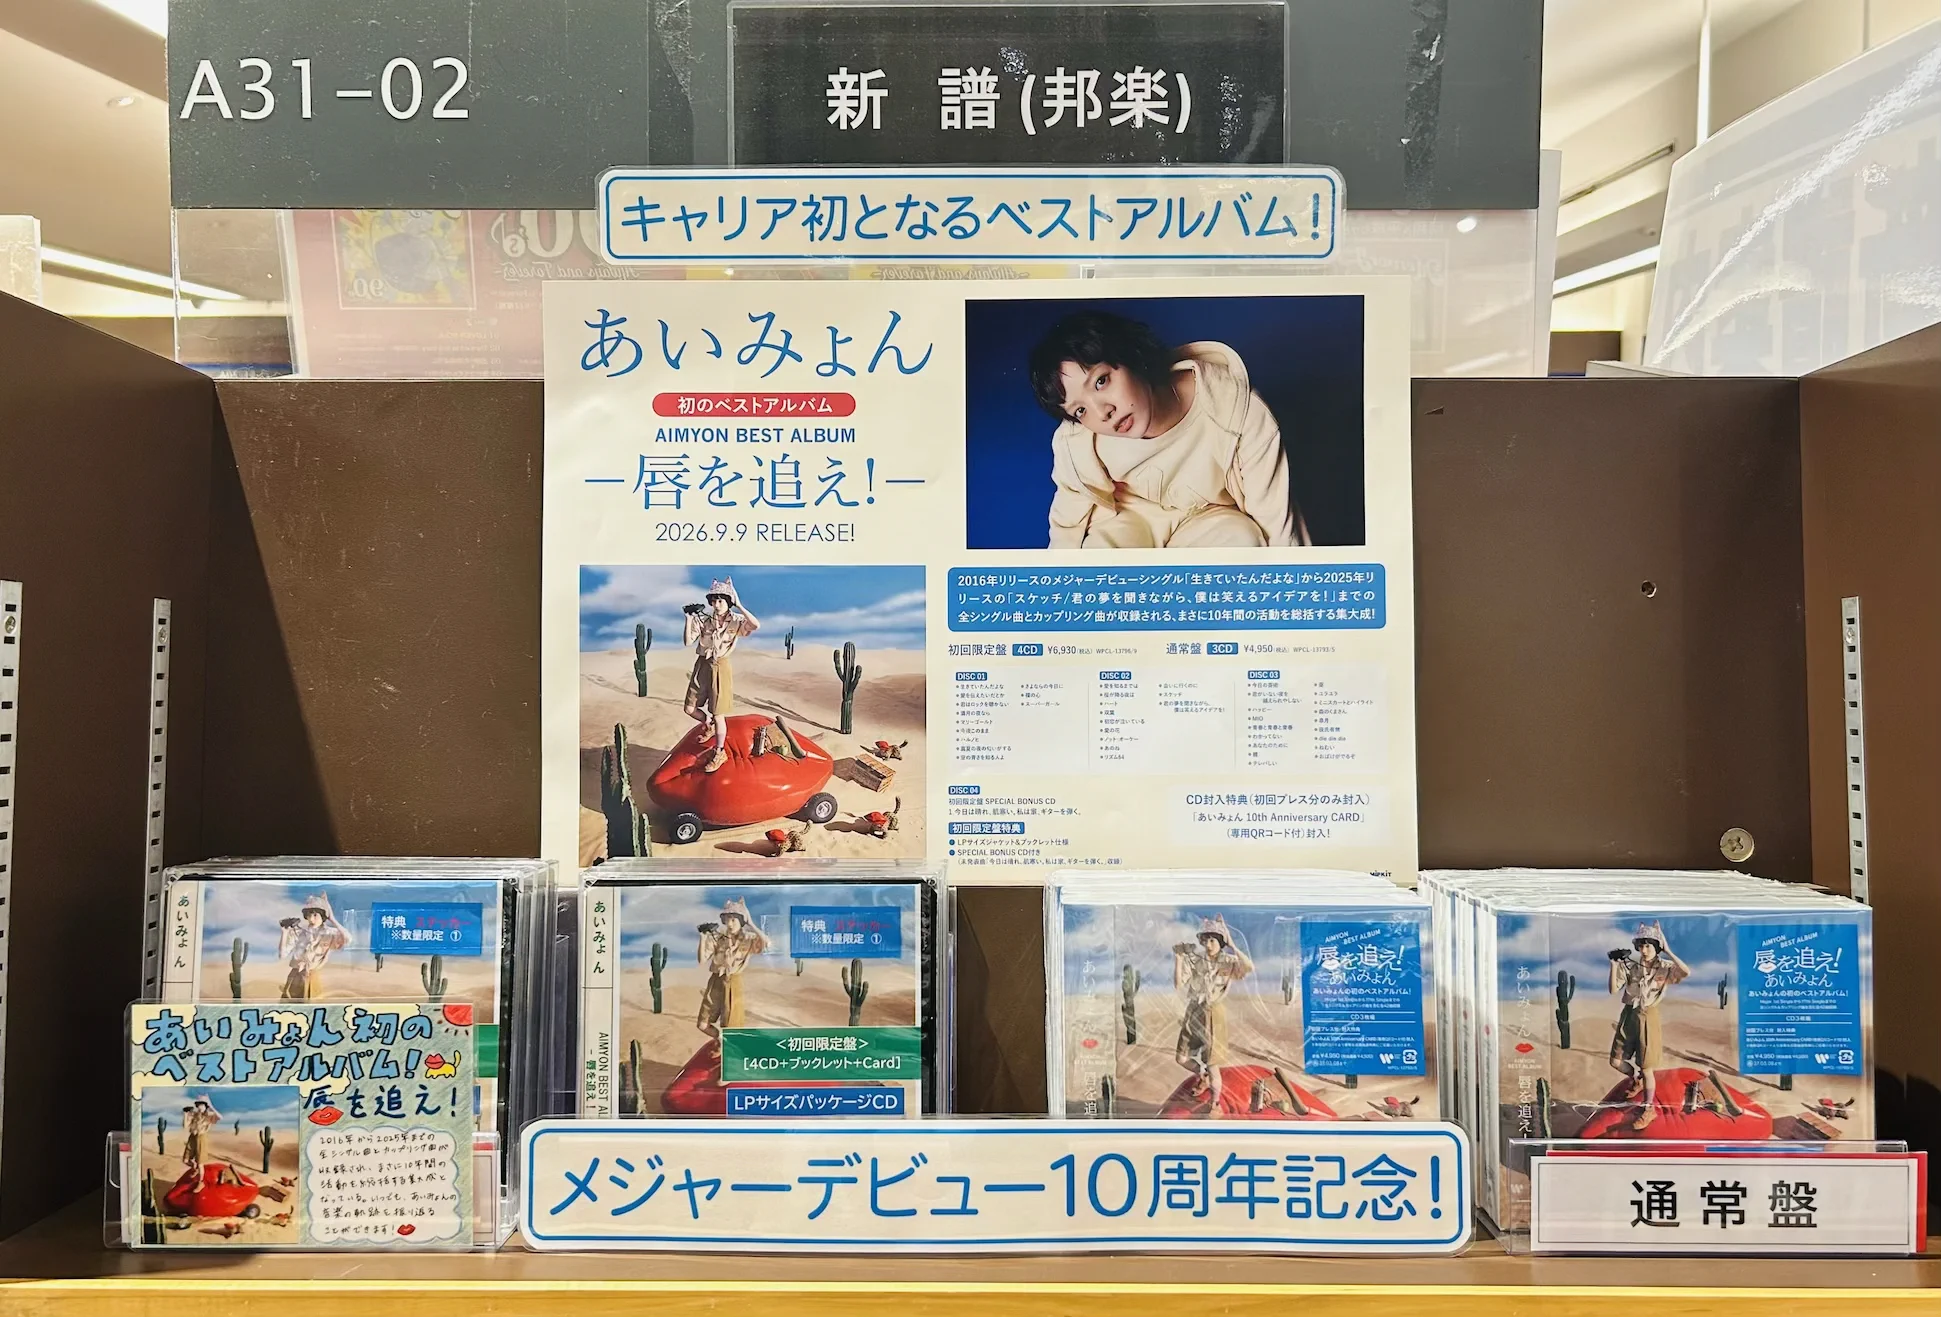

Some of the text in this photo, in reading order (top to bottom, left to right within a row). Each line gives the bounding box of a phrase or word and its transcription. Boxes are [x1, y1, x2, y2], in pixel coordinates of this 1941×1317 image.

[179, 57, 470, 119] A31-02
[621, 192, 1323, 242] キャリア初となるベストアルバム!
[581, 309, 933, 379] あいみょん
[677, 396, 833, 415] 初のベストアルバム
[655, 428, 856, 443] AIMYON BEST ALBUM
[655, 523, 856, 542] 2026.9.9 RELEASE!
[958, 572, 1375, 588] 2016年リリースのメジャーデビューシングル「生きていたんだよな」から2025年リ
[958, 608, 1376, 624] 全シングル曲とカップリング曲が収録される、まさに10年間の活動を総括する集大成!
[948, 644, 1007, 656] 初回限定盤
[1018, 645, 1038, 655] 4CD
[1166, 642, 1202, 655] 通常盤
[1212, 644, 1233, 653] 3CD
[1101, 672, 1130, 680] DISC 02
[1249, 671, 1279, 679] DISC 03
[1246, 812, 1268, 822] 10th
[1270, 813, 1328, 823] Anniversary
[952, 823, 1022, 834] 初回限定盤特典
[381, 915, 406, 928] 特典
[801, 920, 826, 932] 特典
[175, 895, 192, 968] あいみょん
[593, 901, 606, 974] あいみょん
[1325, 931, 1349, 943] AIMYON
[1343, 929, 1381, 945] BEST ALBUM
[1762, 935, 1786, 947] AIMYON
[1780, 932, 1818, 949] BEST ALBUM
[1329, 969, 1396, 986] あいみょん
[1765, 972, 1833, 988] あいみょん
[599, 1032, 609, 1072] AIMYON
[151, 1046, 422, 1083] ベストアルバム!
[743, 1055, 900, 1070] [4CD+ブックレット+Card]
[599, 1075, 609, 1101] BEST
[734, 1094, 898, 1111] LPサイズパッケージCD
[548, 1151, 1443, 1221] メジャーデビュー10周年記念!
[1630, 1180, 1817, 1229] 通常盤
